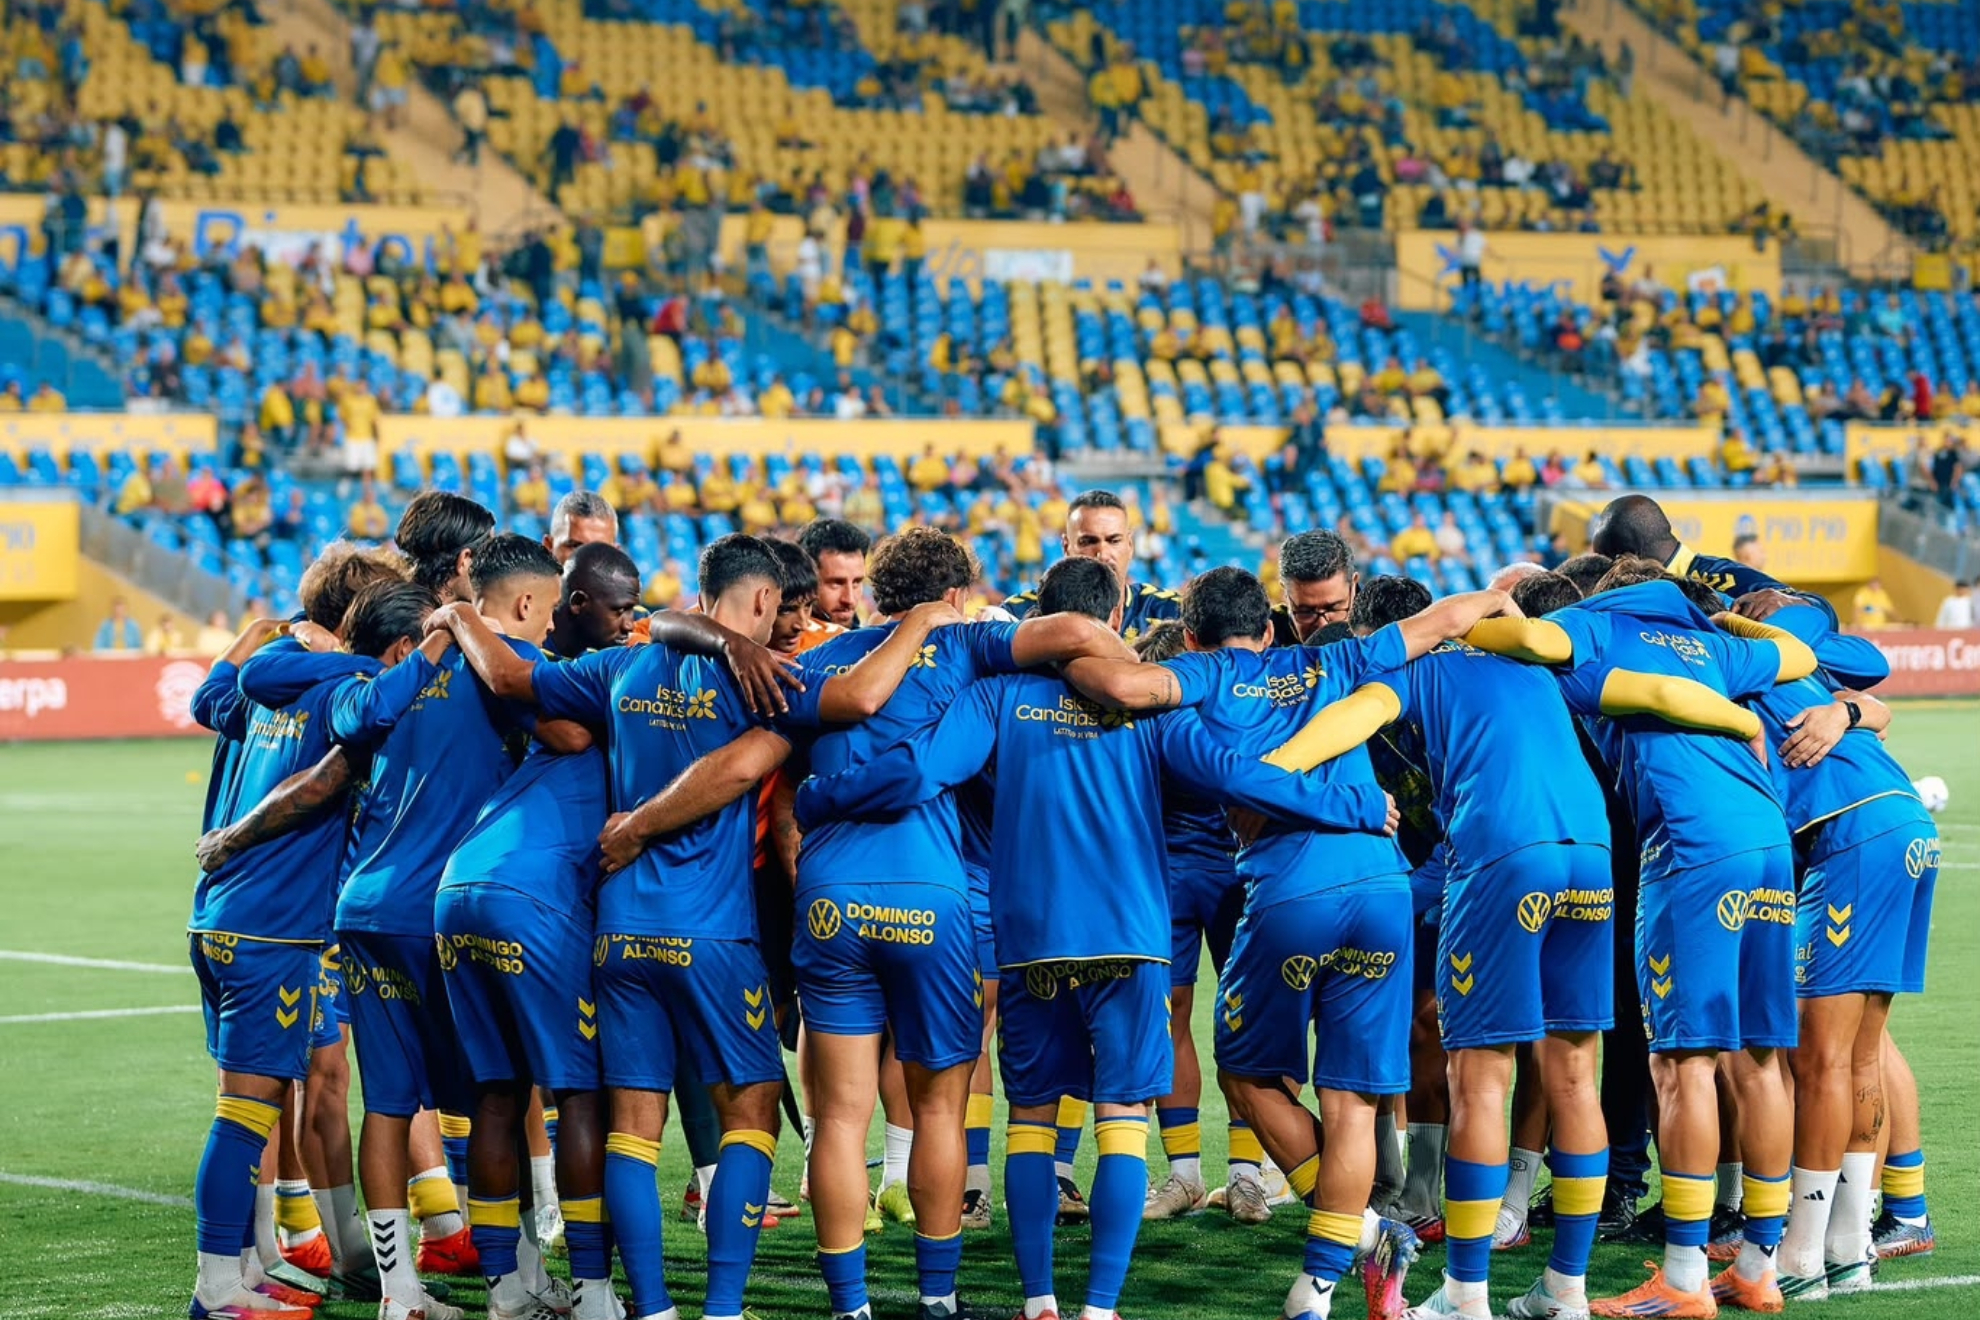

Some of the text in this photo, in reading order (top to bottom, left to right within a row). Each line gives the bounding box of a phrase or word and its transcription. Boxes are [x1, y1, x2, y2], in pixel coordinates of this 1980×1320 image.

[1015, 703, 1099, 726] Canarias
[1553, 886, 1615, 906] DOMINGO
[846, 902, 936, 926] DOMINGO
[859, 923, 934, 945] ALONSO
[622, 943, 692, 967] ALONSO
